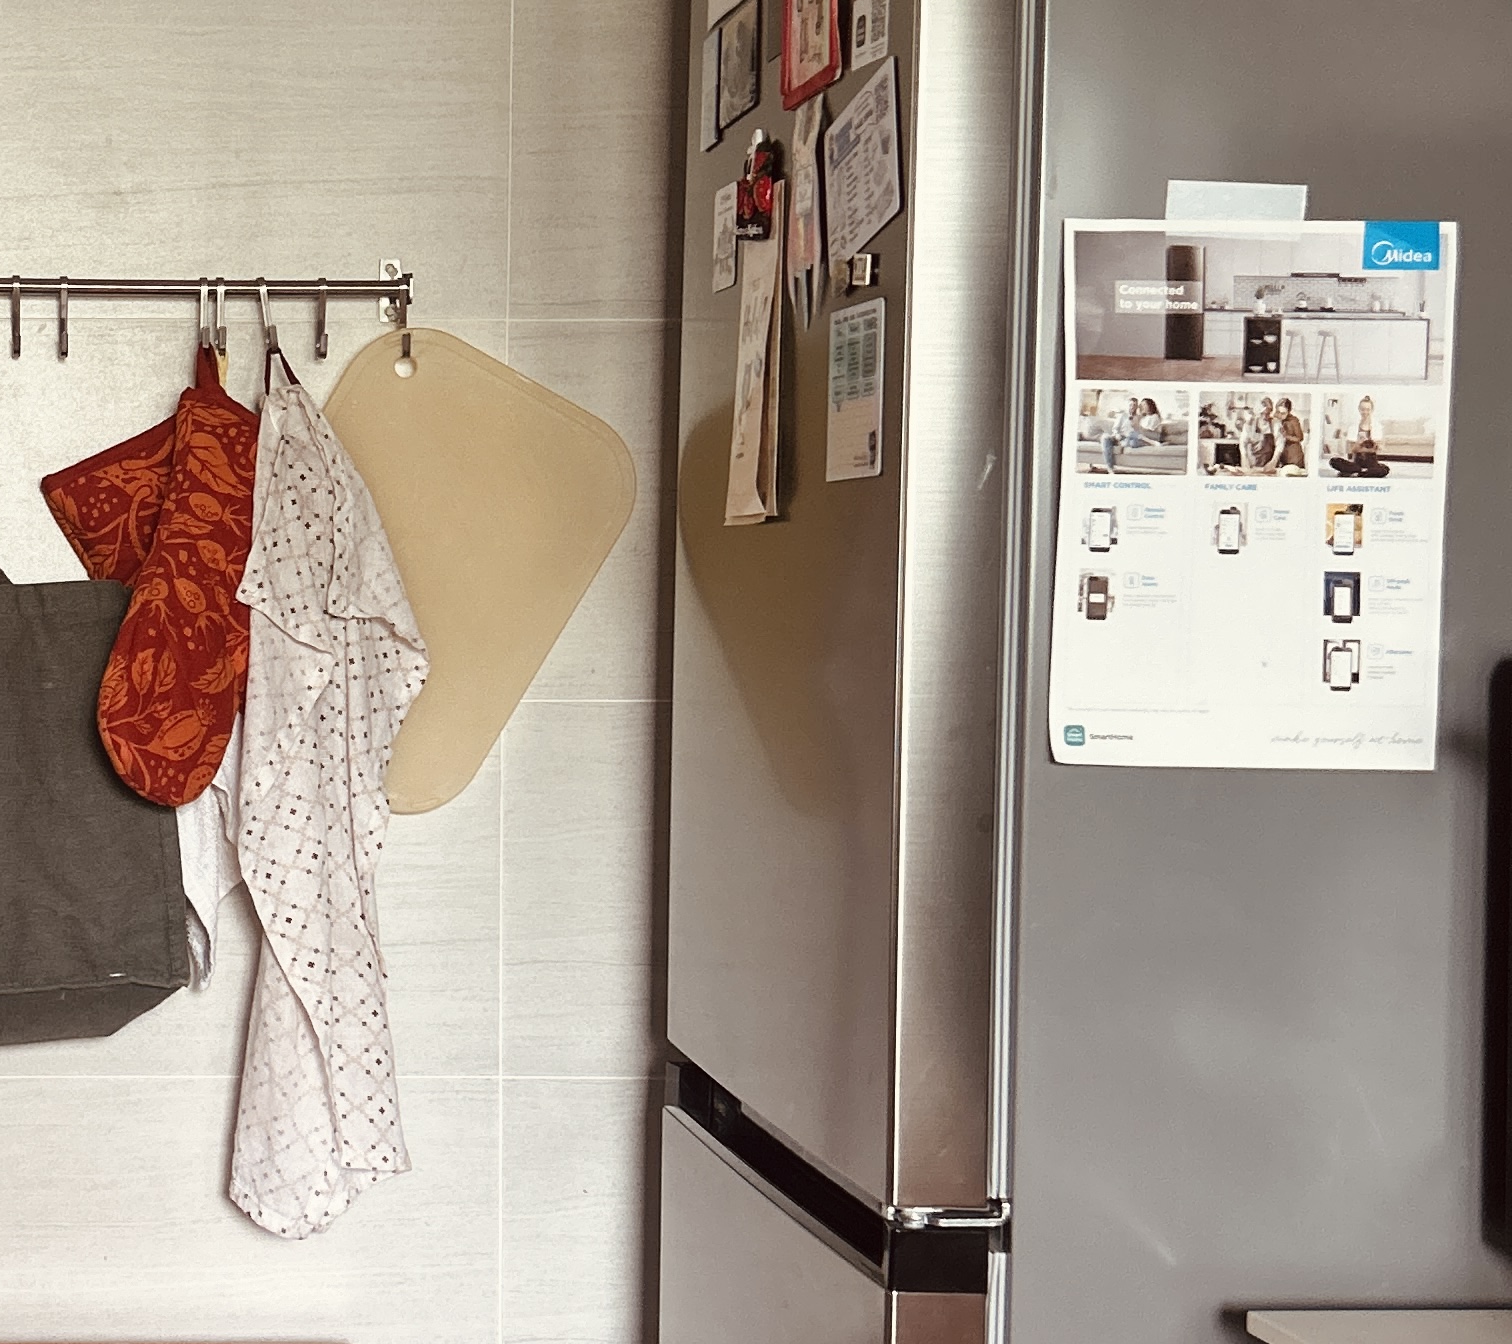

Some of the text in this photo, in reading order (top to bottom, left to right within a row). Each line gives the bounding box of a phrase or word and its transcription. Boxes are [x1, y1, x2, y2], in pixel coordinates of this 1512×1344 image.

[1371, 240, 1433, 266] Midea
[1119, 284, 1185, 296] Connected
[1119, 299, 1199, 313] to your home
[1204, 483, 1235, 491] FAMILY
[1346, 485, 1391, 494] ASSISTANT
